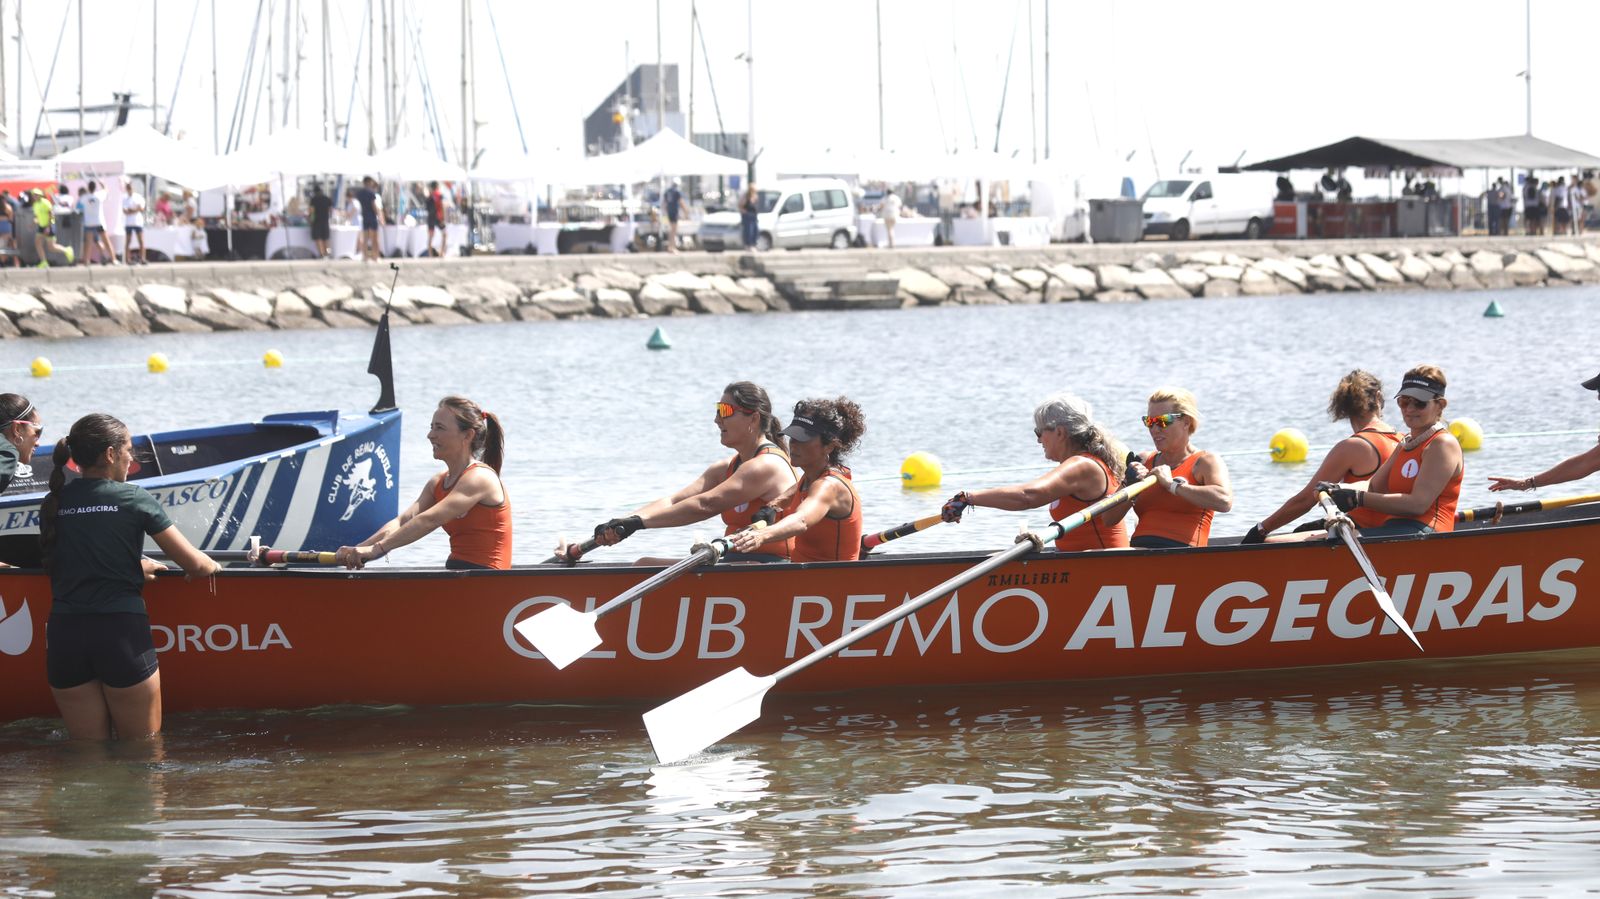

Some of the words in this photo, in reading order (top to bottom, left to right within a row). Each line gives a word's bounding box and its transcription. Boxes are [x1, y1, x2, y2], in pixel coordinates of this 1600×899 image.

[328, 474, 342, 503] CLUB
[341, 454, 354, 473] DE
[354, 440, 375, 459] REMO
[77, 505, 119, 514] ALGECIRAS
[785, 587, 1049, 659] REMO
[1063, 557, 1585, 651] ALGECIRAS
